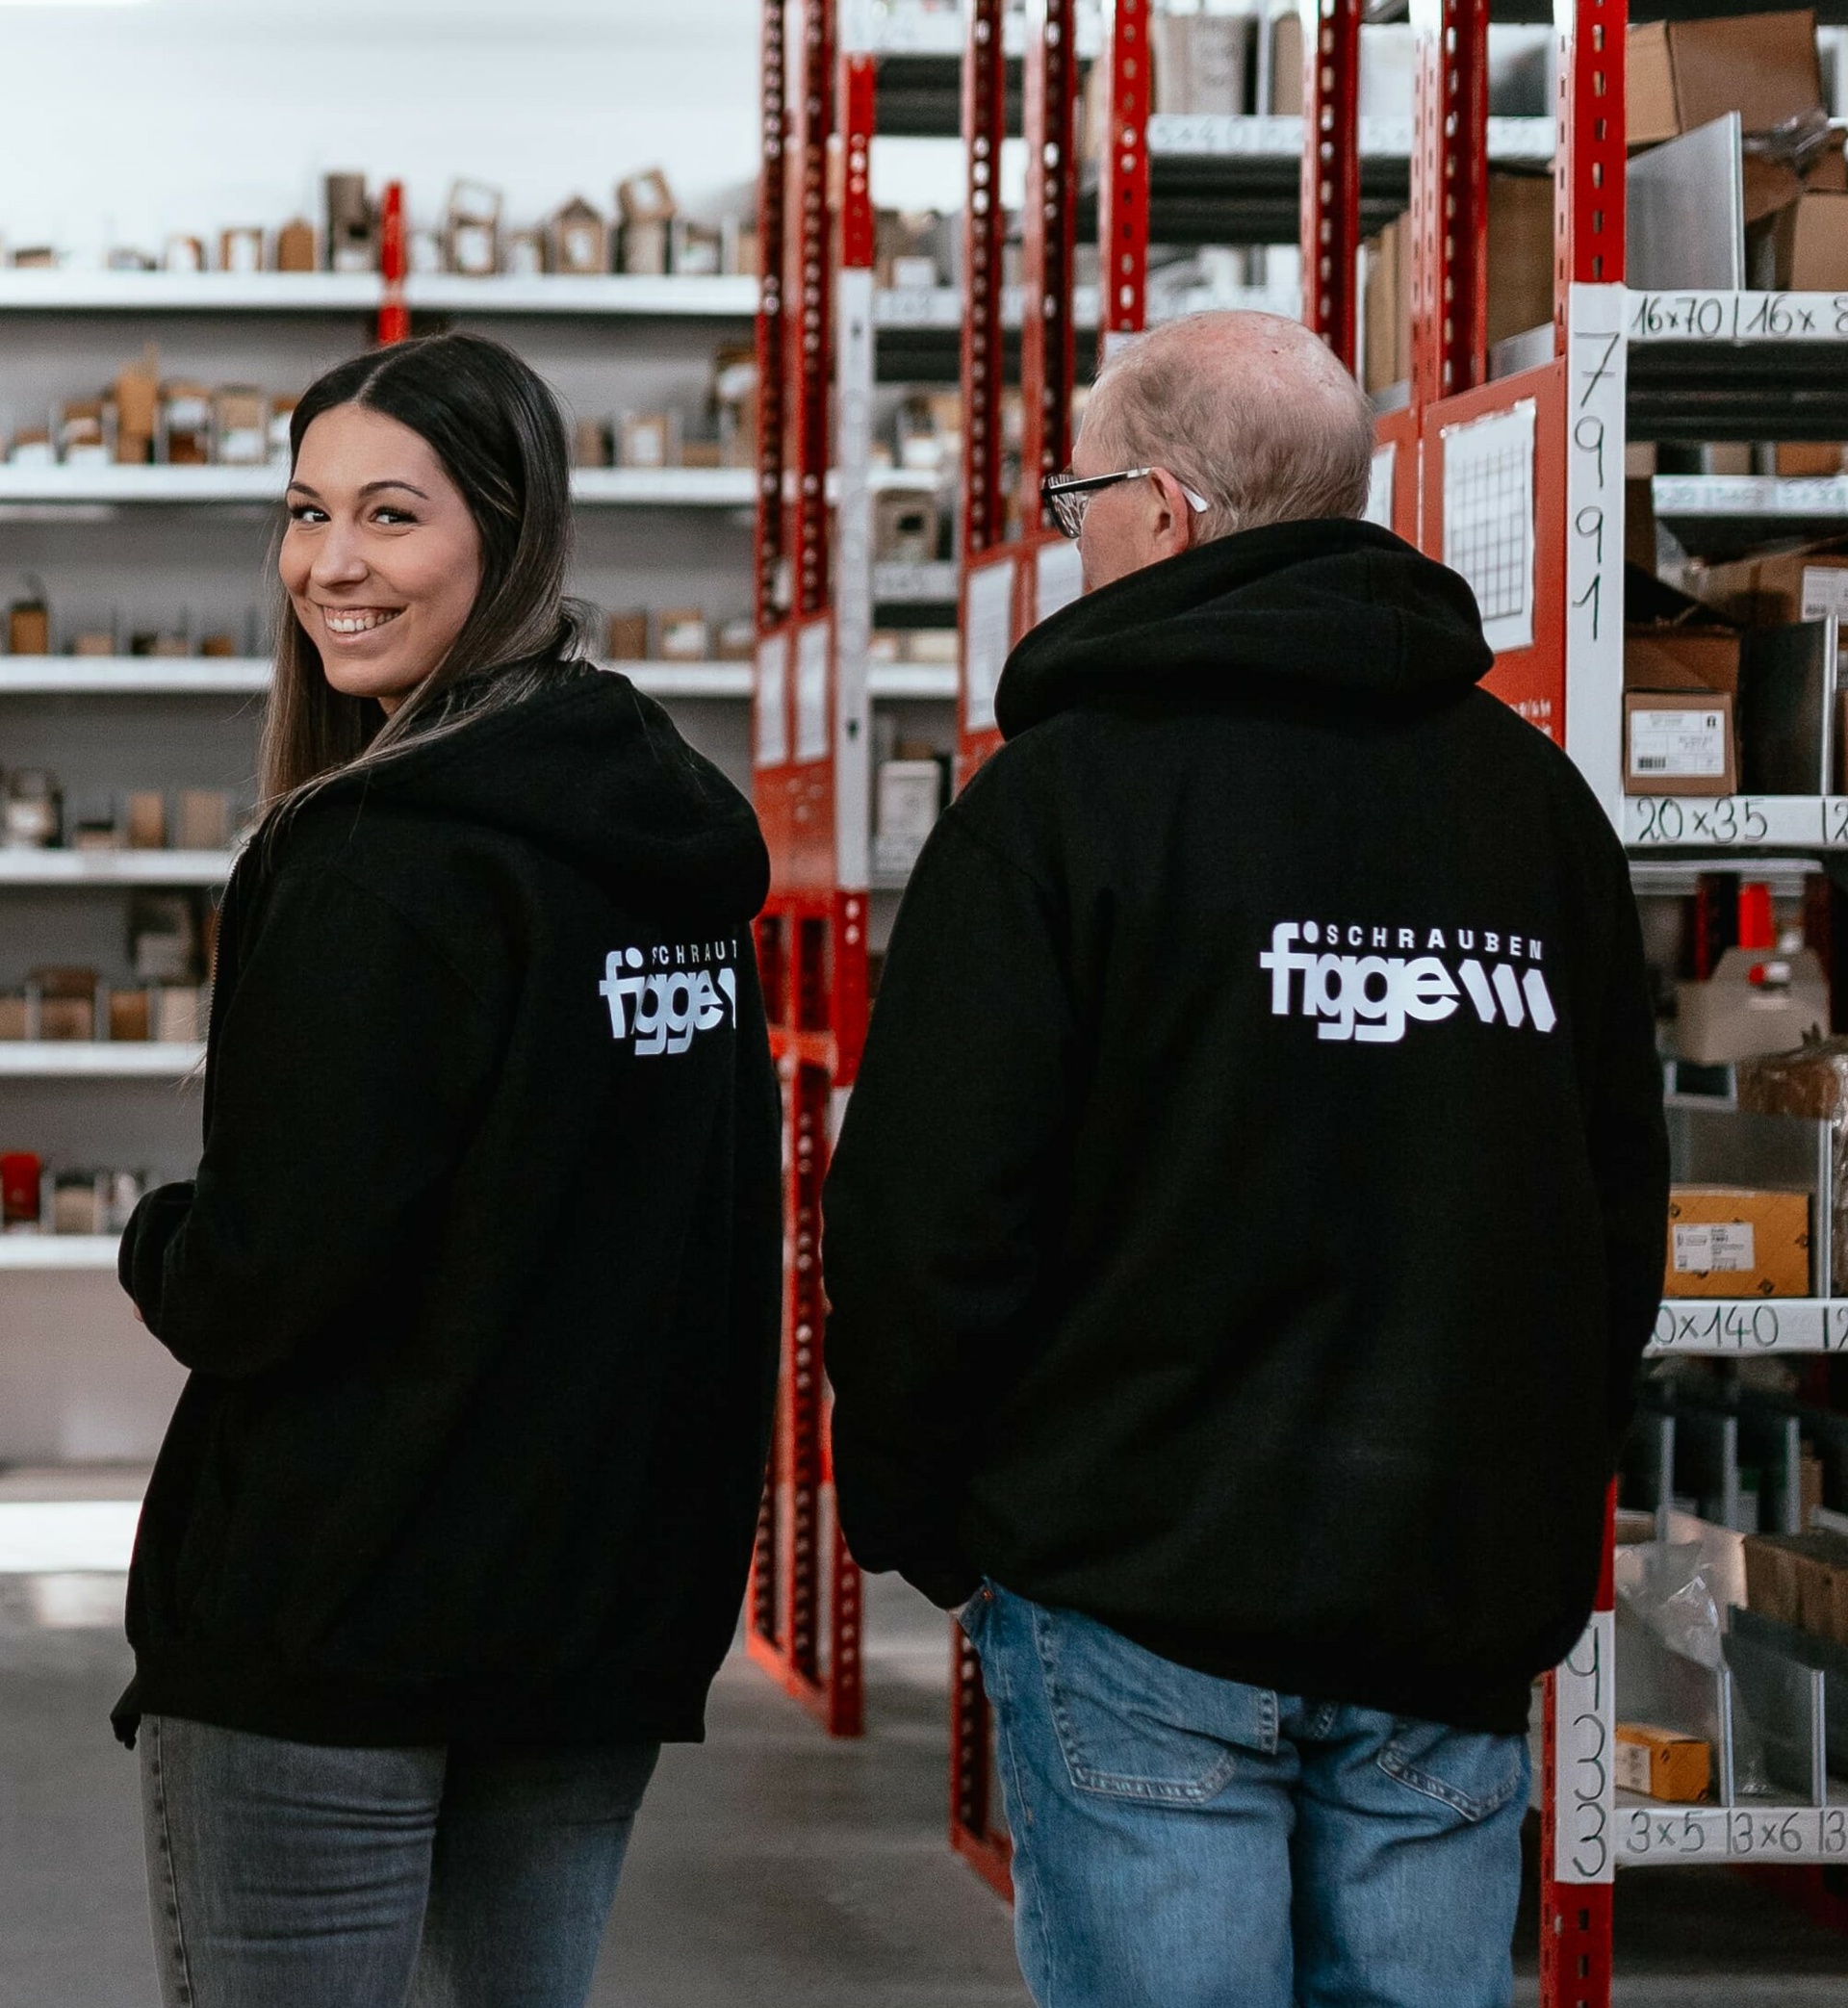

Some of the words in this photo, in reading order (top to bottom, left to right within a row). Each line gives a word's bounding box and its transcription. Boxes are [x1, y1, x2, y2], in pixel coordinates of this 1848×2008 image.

[1631, 294, 1723, 337] 16x70
[1637, 796, 1768, 844] 20x35
[1326, 923, 1542, 961] SCHRAUBEN
[1260, 920, 1461, 1043] figge
[1626, 1809, 1706, 1854] 3x5
[1732, 1811, 1803, 1855] 3x6
